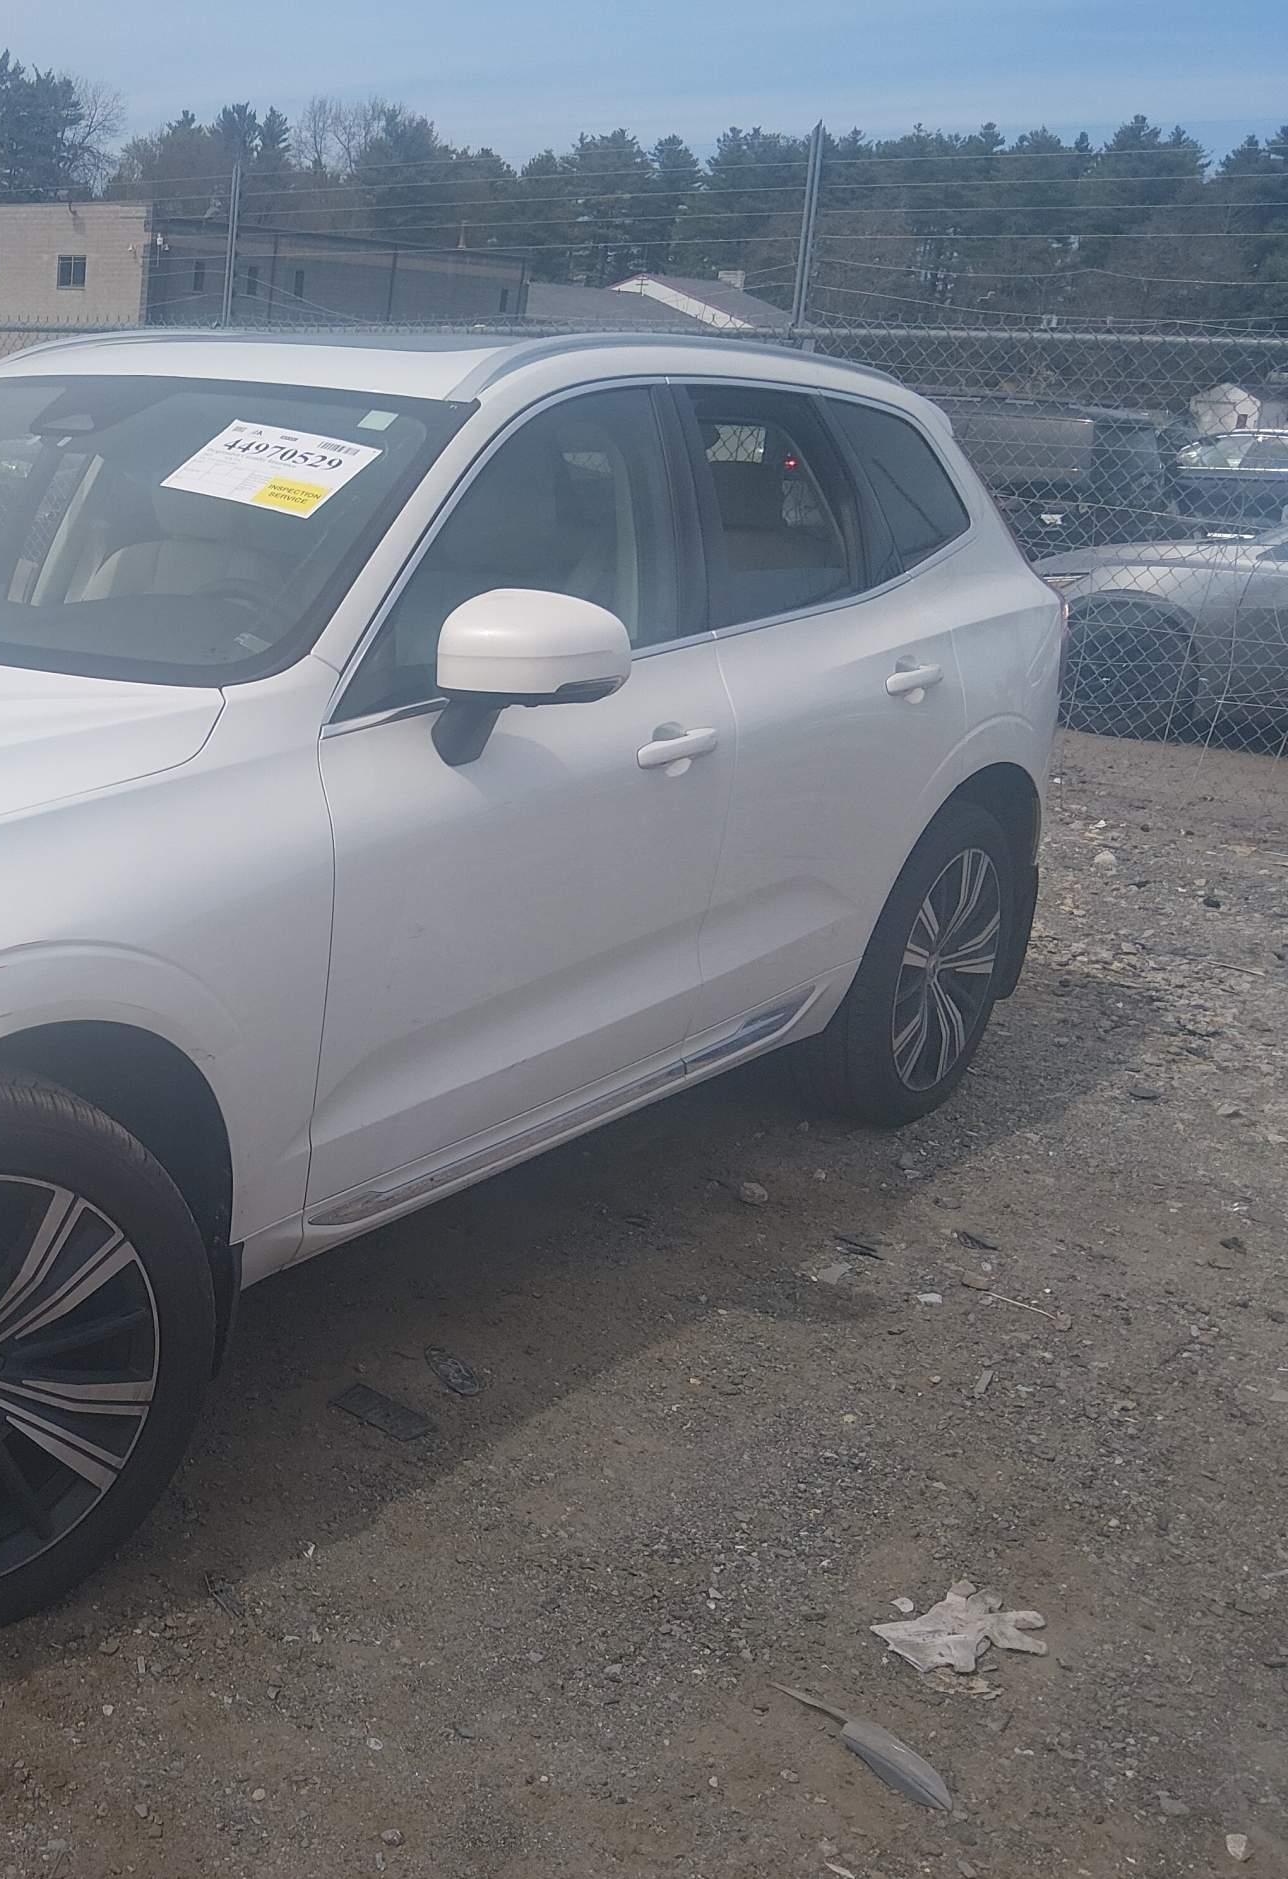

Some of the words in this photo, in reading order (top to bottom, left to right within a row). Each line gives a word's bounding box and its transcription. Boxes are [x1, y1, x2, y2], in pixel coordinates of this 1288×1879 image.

[224, 438, 343, 470] 44970529
[267, 483, 321, 500] INSPECTION
[267, 491, 308, 505] SERVICE
